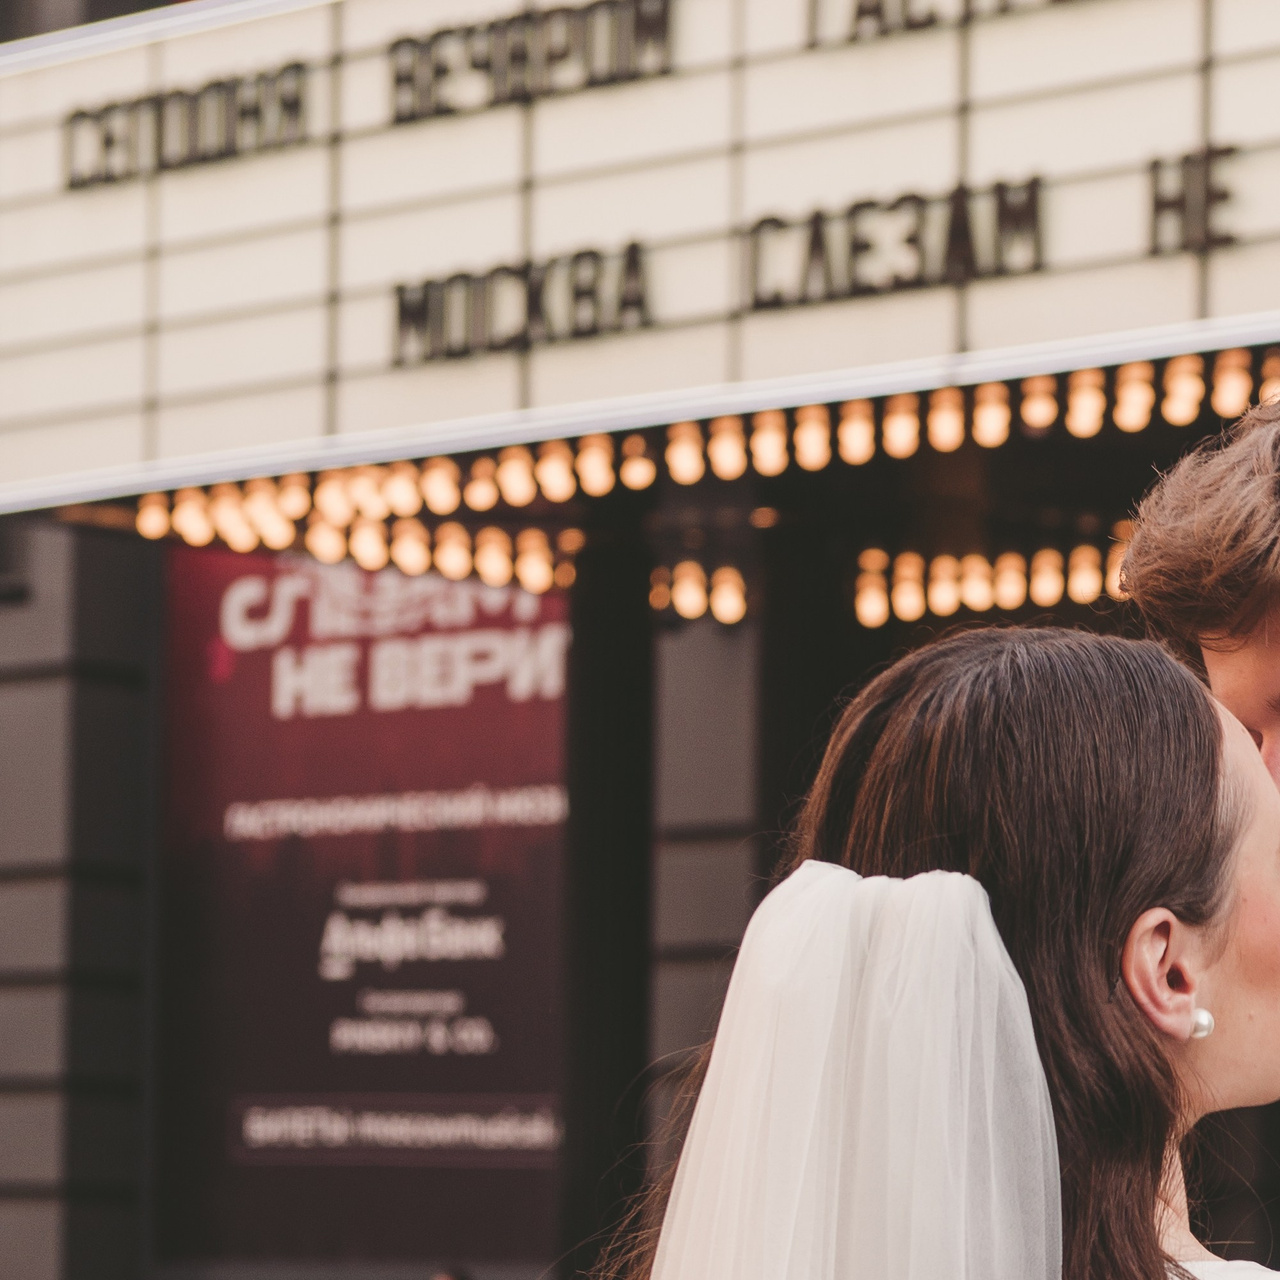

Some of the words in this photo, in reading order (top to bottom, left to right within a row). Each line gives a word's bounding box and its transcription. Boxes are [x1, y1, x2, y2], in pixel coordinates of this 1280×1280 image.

[61, 60, 308, 189] СЕГОДНЯ
[394, 242, 653, 367] МОСКВА
[750, 176, 1045, 308] СЛЕЗАМ
[1148, 146, 1239, 256] НЕ
[272, 641, 361, 719] НЕ
[367, 624, 571, 711] ВЕРИ
